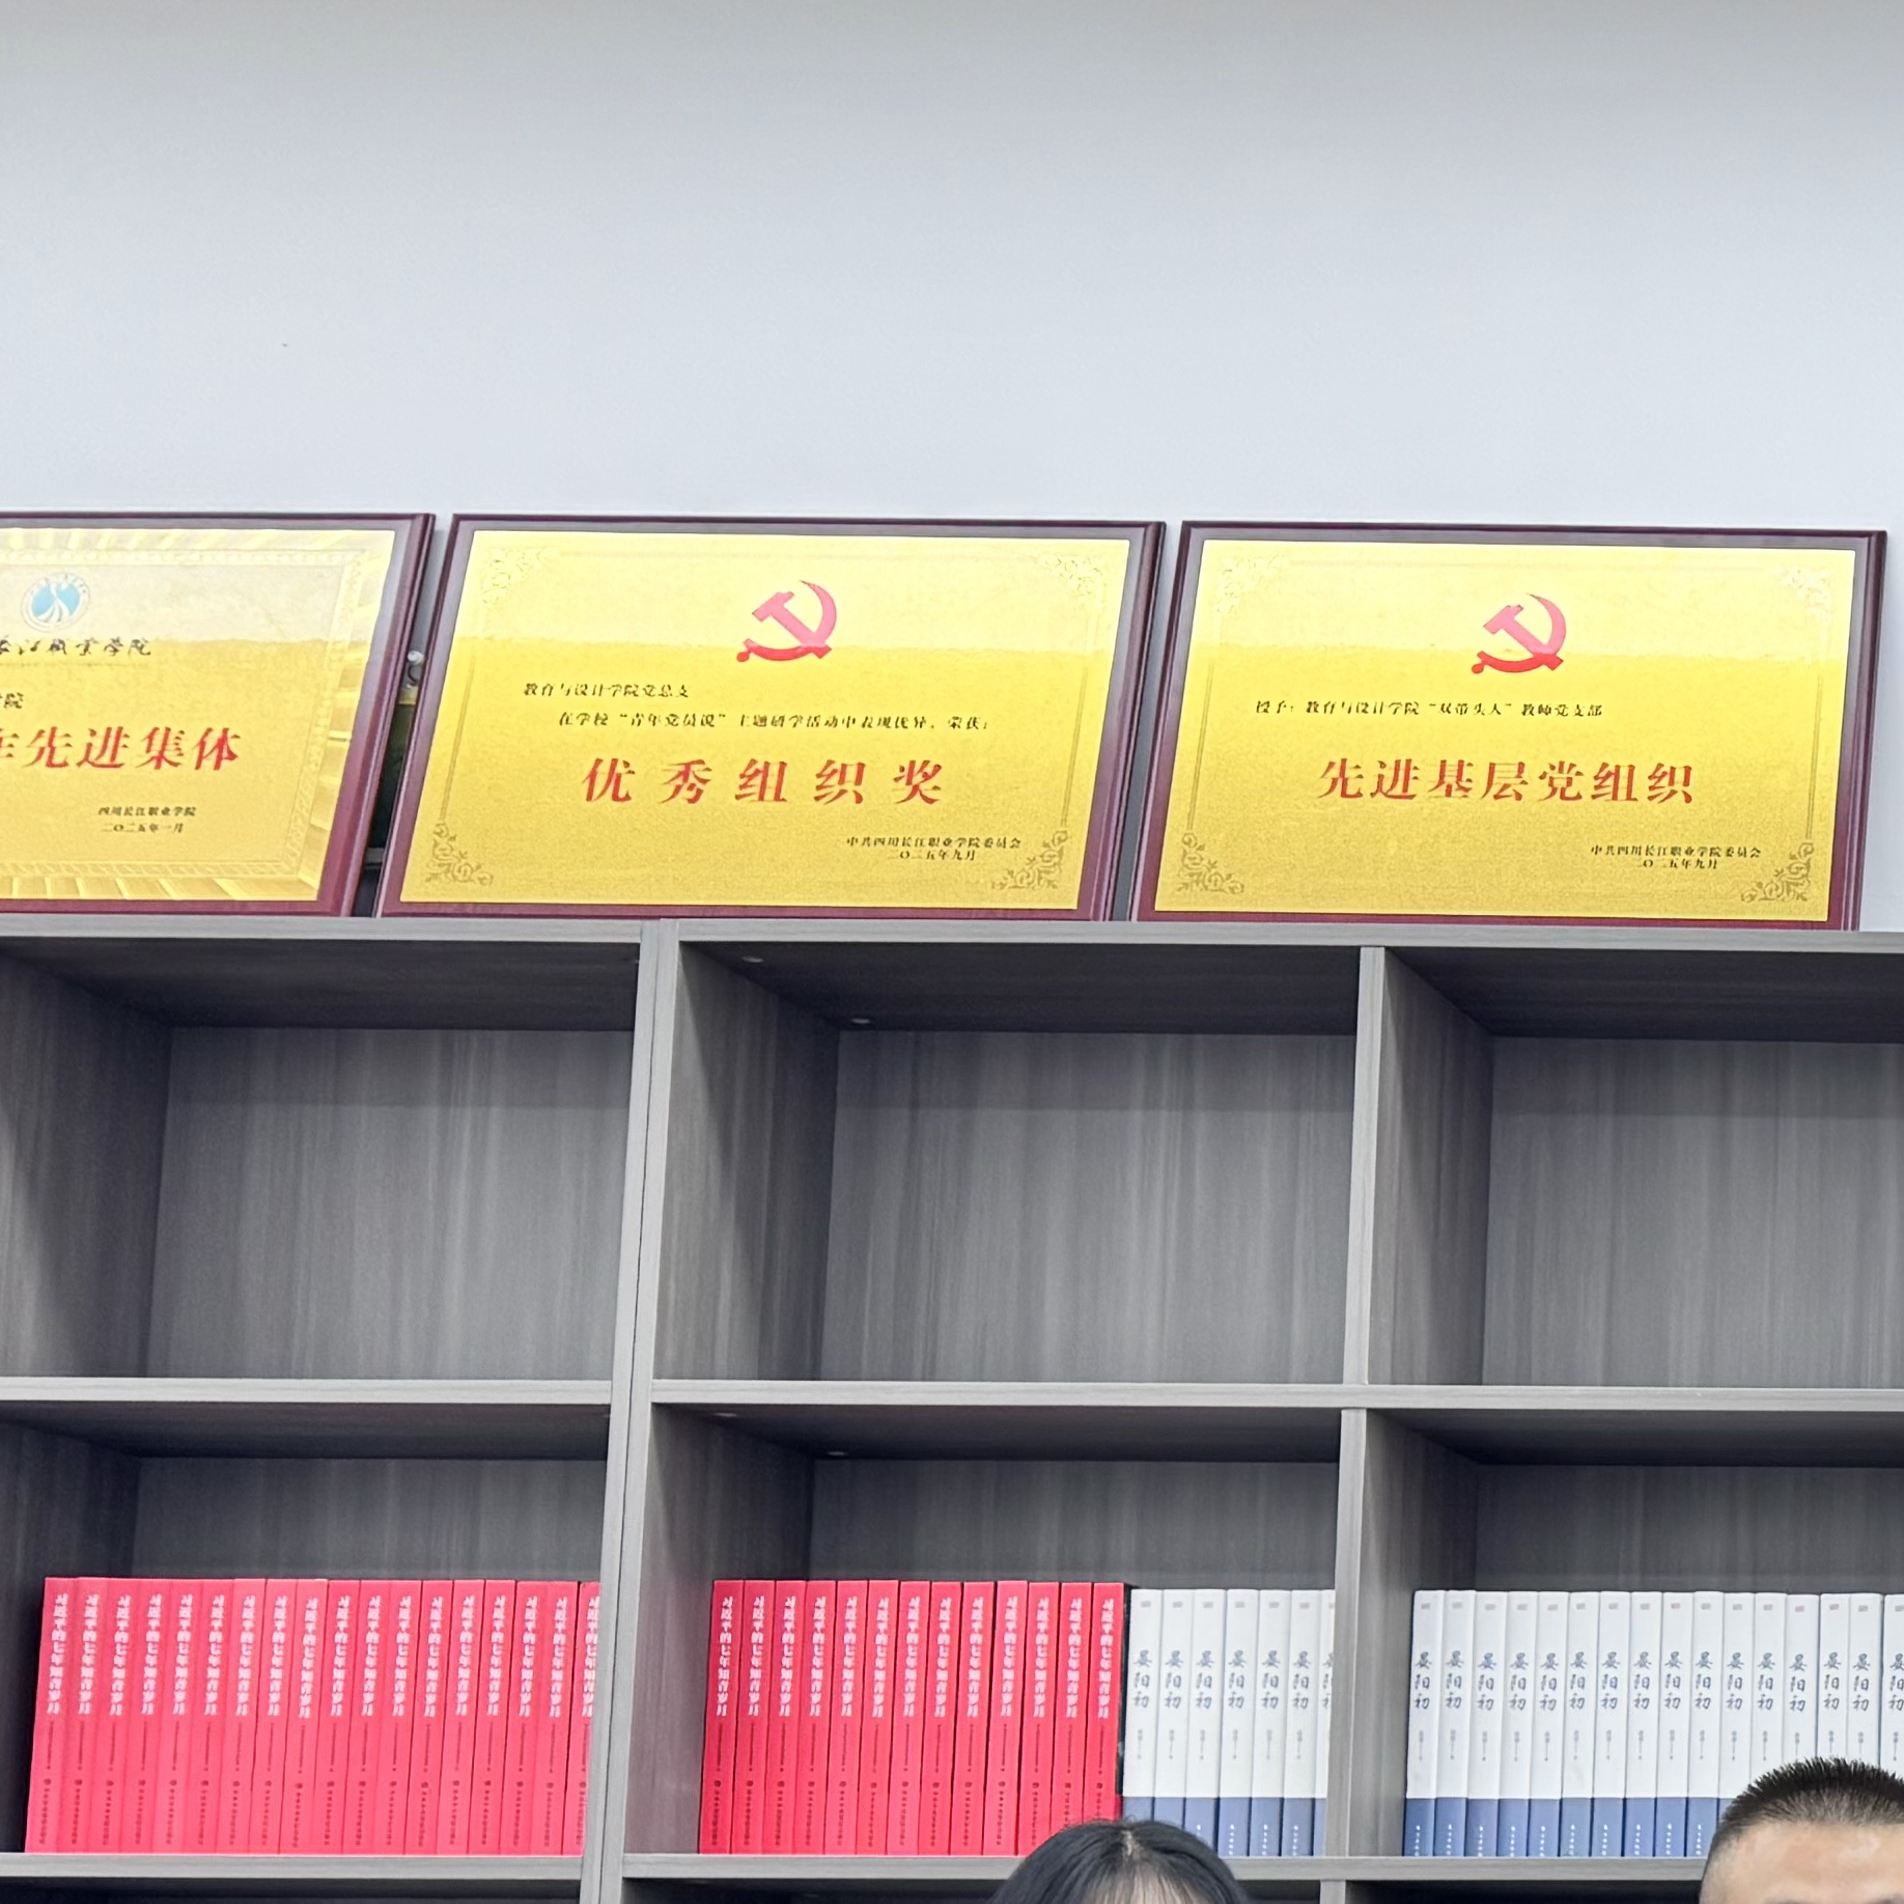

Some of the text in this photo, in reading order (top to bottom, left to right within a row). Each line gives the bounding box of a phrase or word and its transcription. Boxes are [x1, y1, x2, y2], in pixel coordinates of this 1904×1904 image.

[582, 757, 943, 806] 优秀组织奖
[1317, 757, 1695, 804] 先进基层党组织
